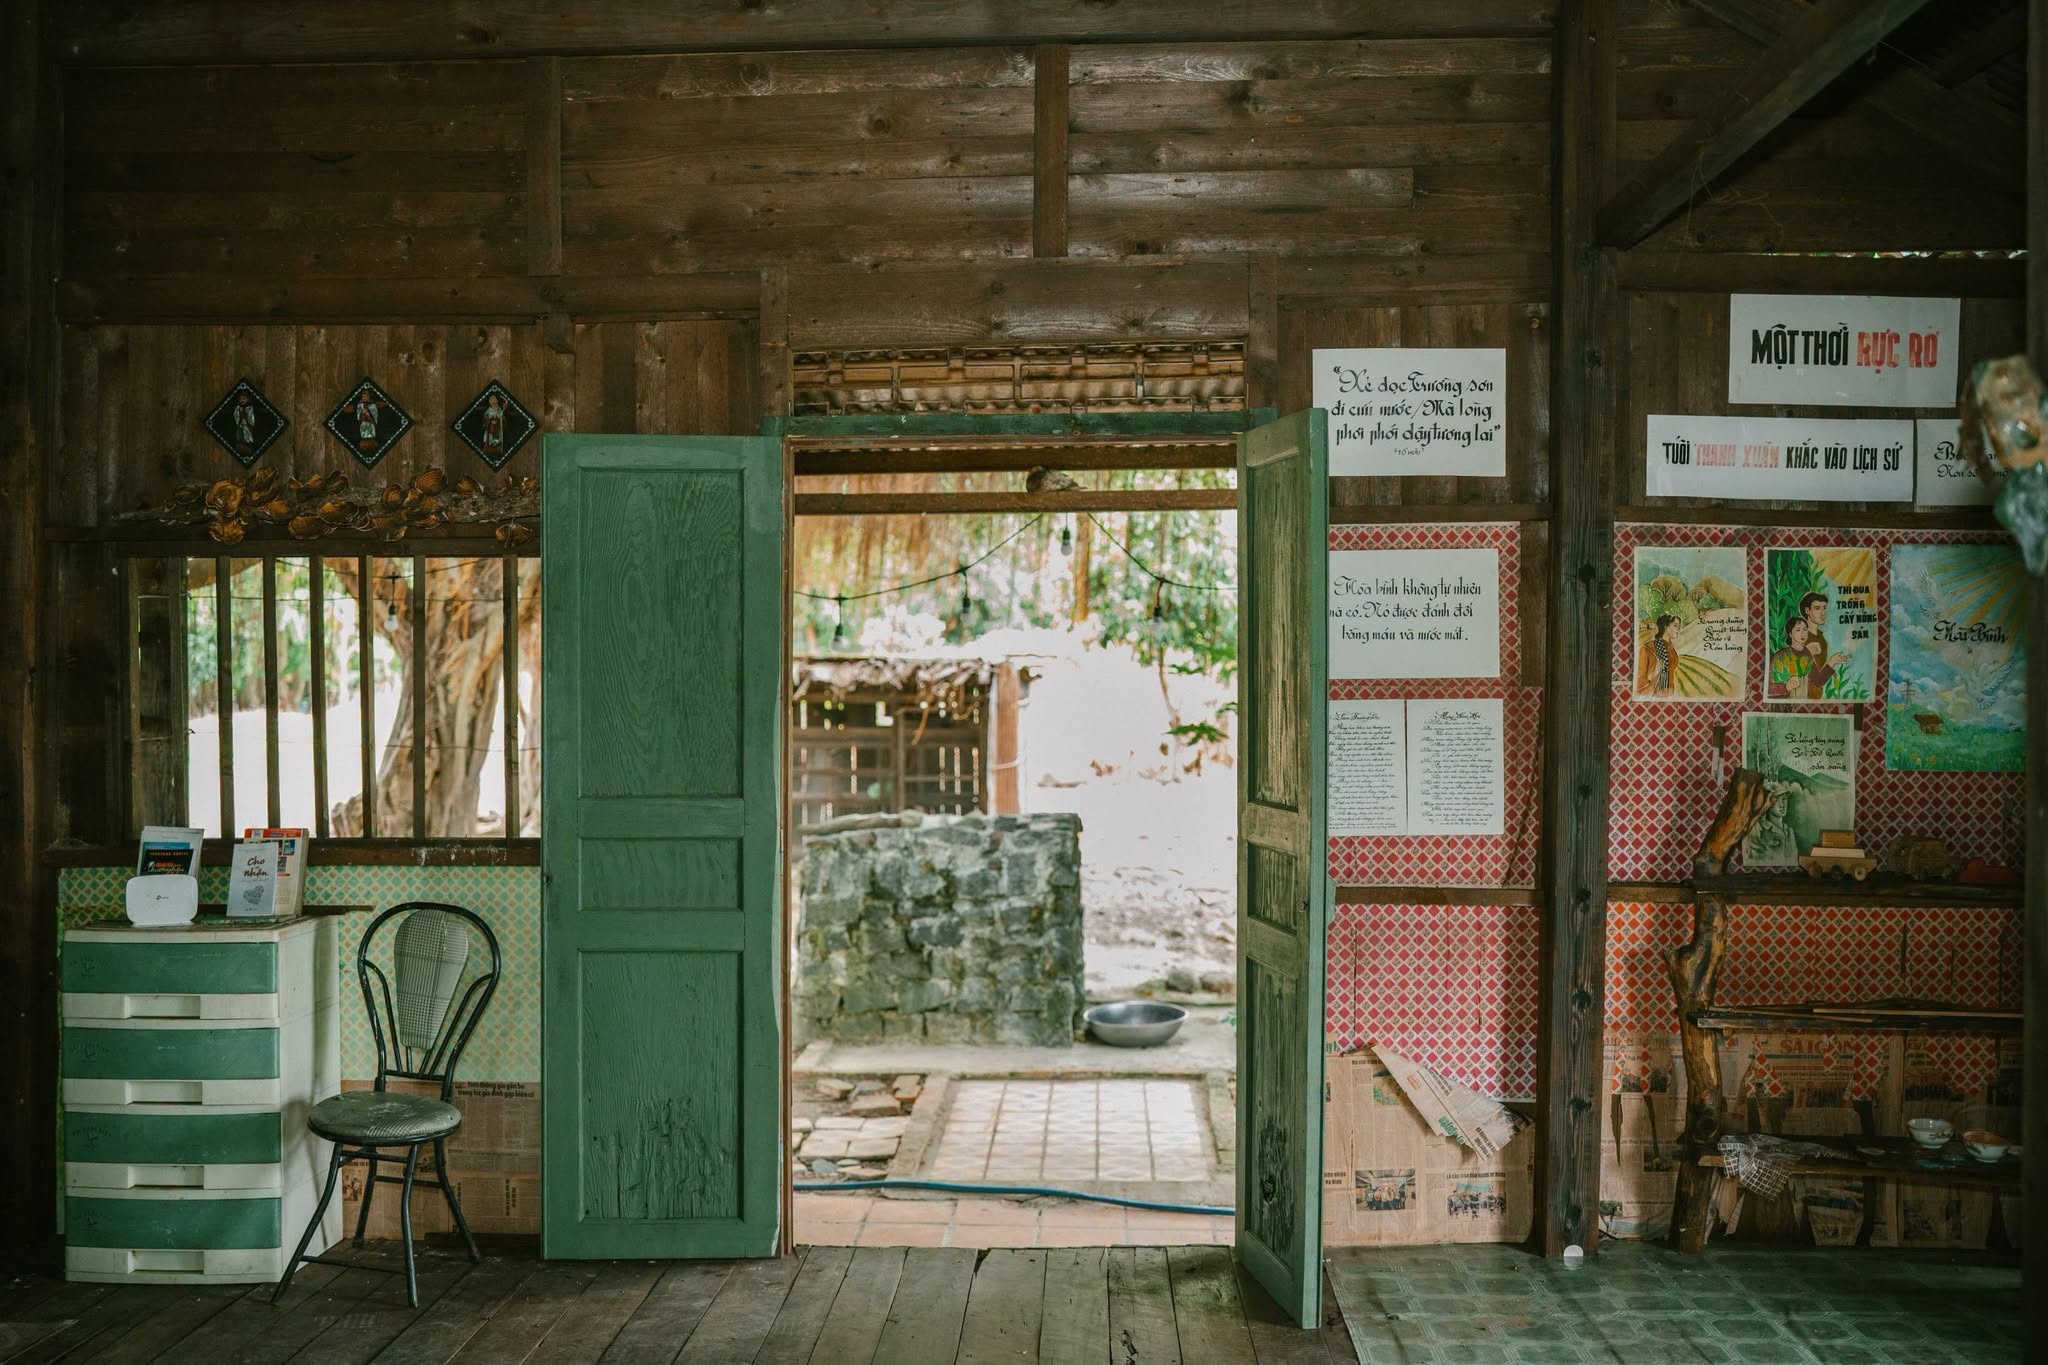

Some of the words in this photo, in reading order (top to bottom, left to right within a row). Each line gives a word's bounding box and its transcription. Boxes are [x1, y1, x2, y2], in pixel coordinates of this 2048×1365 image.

[1751, 323, 1799, 370] MỘT
[1801, 321, 1849, 366] THỜI
[1856, 328, 1900, 374] RỰC
[1377, 376, 1410, 394] dọc
[1407, 371, 1462, 398] Trường
[1331, 400, 1345, 416] đi
[1459, 398, 1492, 422] lòng
[1336, 424, 1364, 446] phơi
[1369, 422, 1398, 446] phới
[1402, 424, 1431, 447] dậy
[1430, 423, 1471, 448] tương
[1696, 443, 1736, 467] THANH
[1785, 438, 1818, 469] KHẮC
[1824, 442, 1847, 470] VÀO
[1852, 443, 1877, 474] LỊCH
[1375, 577, 1398, 596] bình
[1403, 577, 1438, 601] không
[1438, 577, 1450, 597] tự
[1453, 576, 1481, 595] nhiên
[1853, 585, 1871, 594] ĐUA
[1362, 601, 1390, 618] Nó
[1392, 603, 1418, 620] được
[1422, 602, 1450, 618] đánh
[1836, 598, 1865, 609] TRỒNG
[1856, 611, 1877, 623] NÔNG
[1342, 624, 1370, 644] bằng
[1372, 627, 1396, 640] máu
[1399, 628, 1414, 640] và
[1418, 626, 1441, 640] nước
[247, 856, 265, 866] Cho
